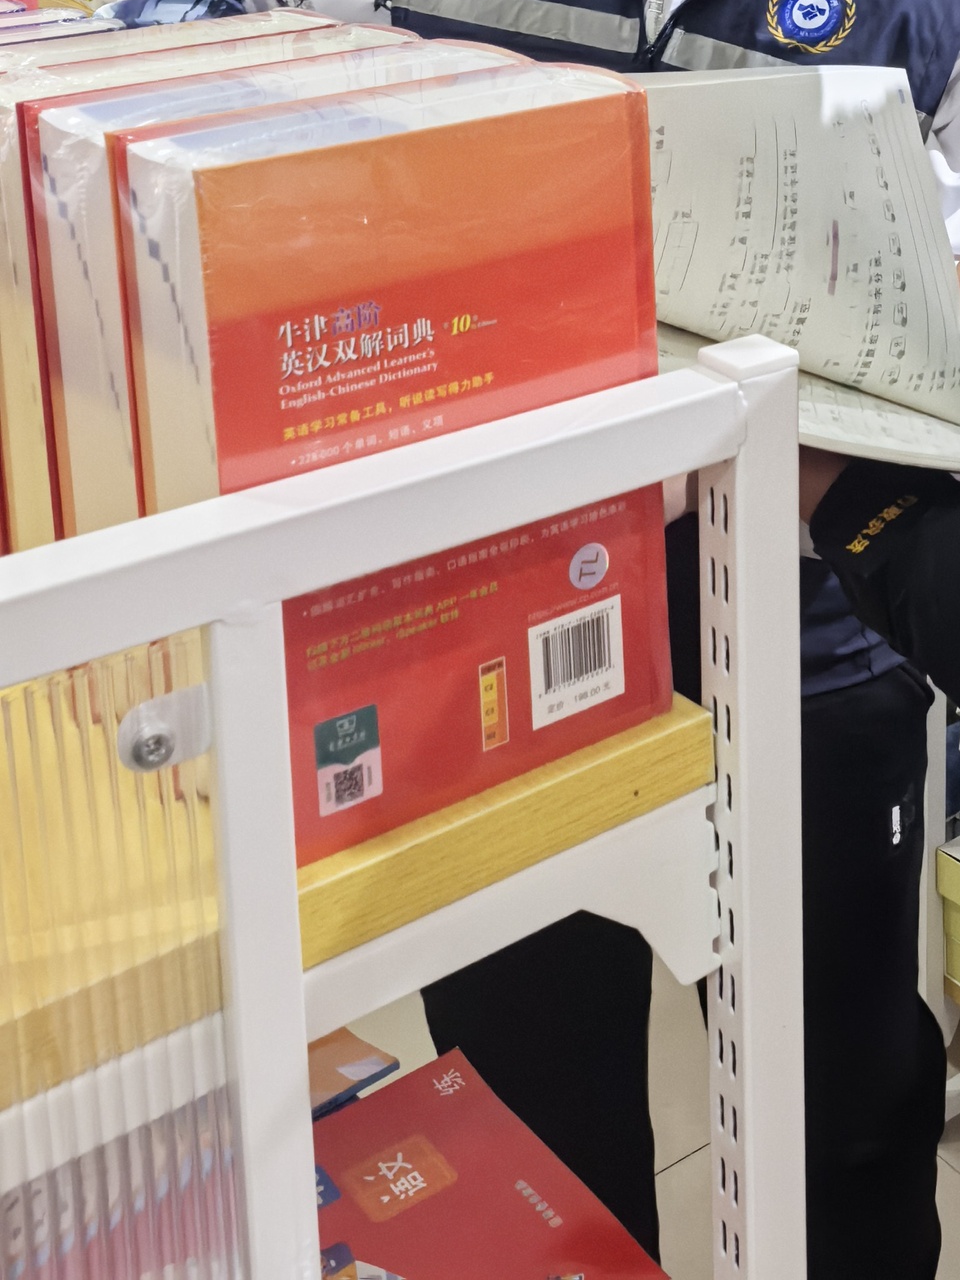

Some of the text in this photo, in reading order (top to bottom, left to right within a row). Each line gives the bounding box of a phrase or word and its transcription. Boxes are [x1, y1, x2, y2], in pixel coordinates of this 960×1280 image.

[279, 347, 435, 396] Oxford Advanced Learner's
[281, 317, 435, 380] 英汉双解词典
[280, 362, 439, 410] English-Chinese Dictionary
[433, 1068, 466, 1097] 练
[377, 1152, 428, 1201] 语文
